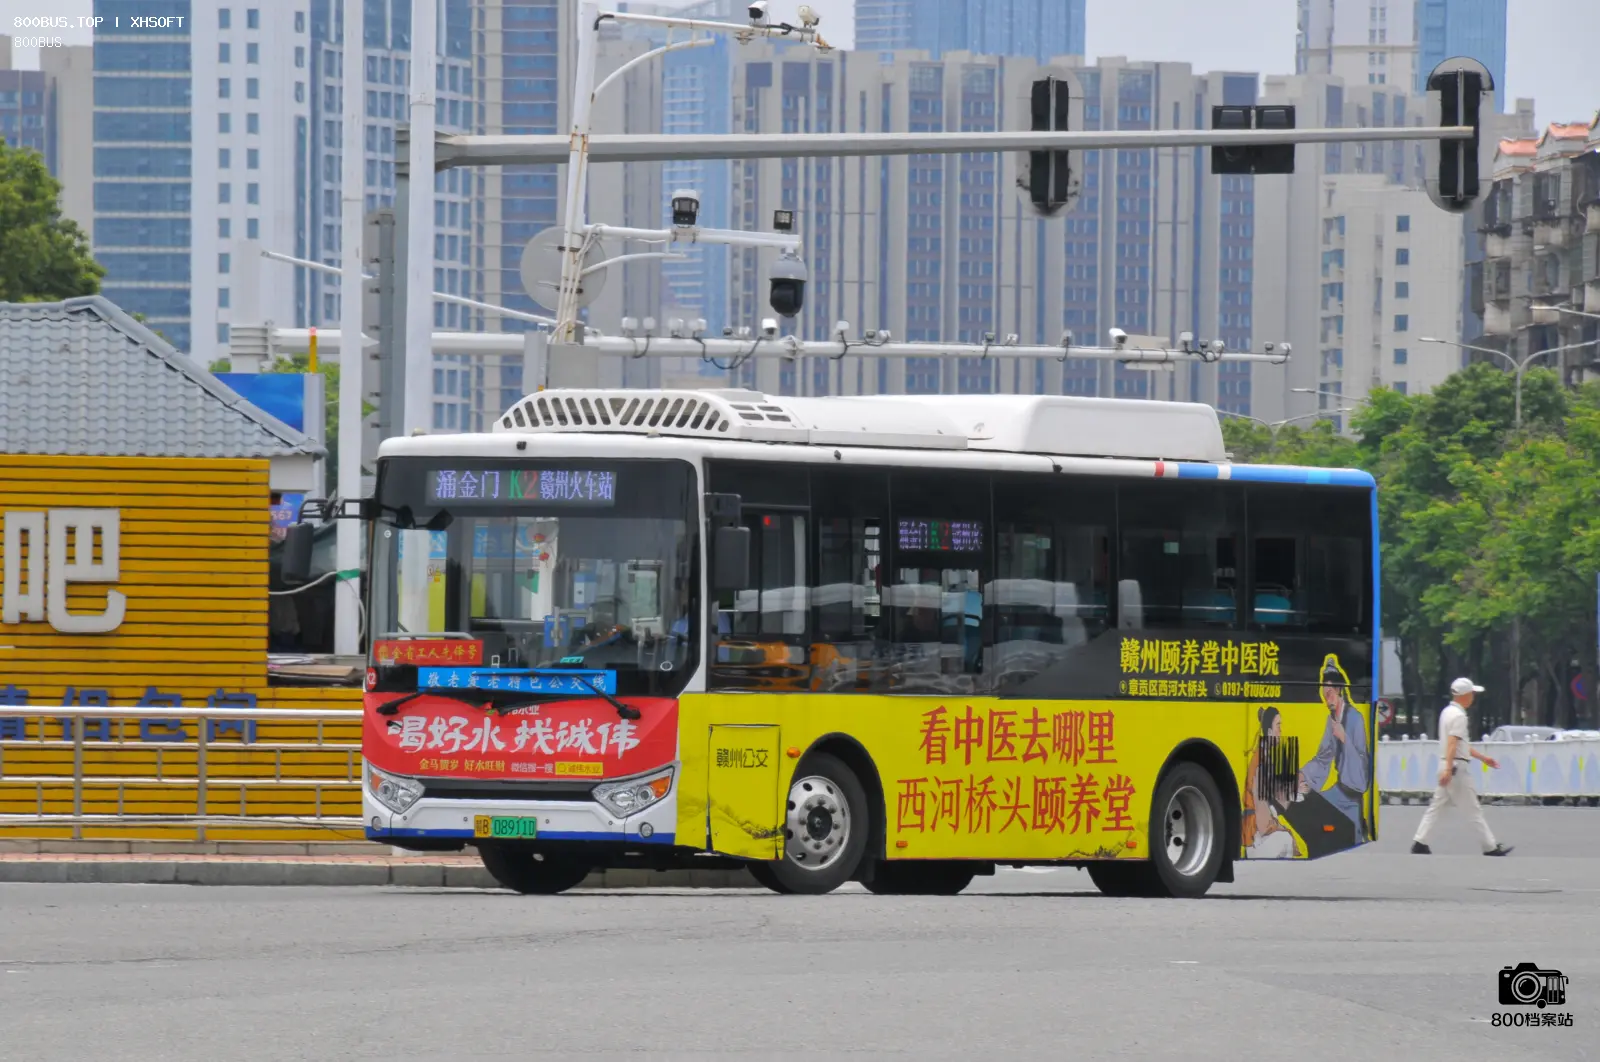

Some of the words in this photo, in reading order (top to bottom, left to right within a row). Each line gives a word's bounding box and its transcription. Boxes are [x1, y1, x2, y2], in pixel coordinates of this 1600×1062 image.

[436, 470, 500, 498] 涌金门
[508, 470, 539, 499] K2
[540, 470, 613, 500] 赣州火车站
[3, 507, 127, 633] 吧
[1120, 637, 1280, 676] 赣州颐养堂中医院
[1128, 679, 1208, 697] 章贡区西河大桥头
[387, 715, 506, 754] 喝好水
[509, 717, 641, 759] 找诚伟
[919, 705, 1118, 767] 看中医去哪里
[464, 760, 506, 773] 好水旺财
[716, 748, 769, 768] 赣州公交
[896, 773, 1137, 835] 西河桥头颐养堂
